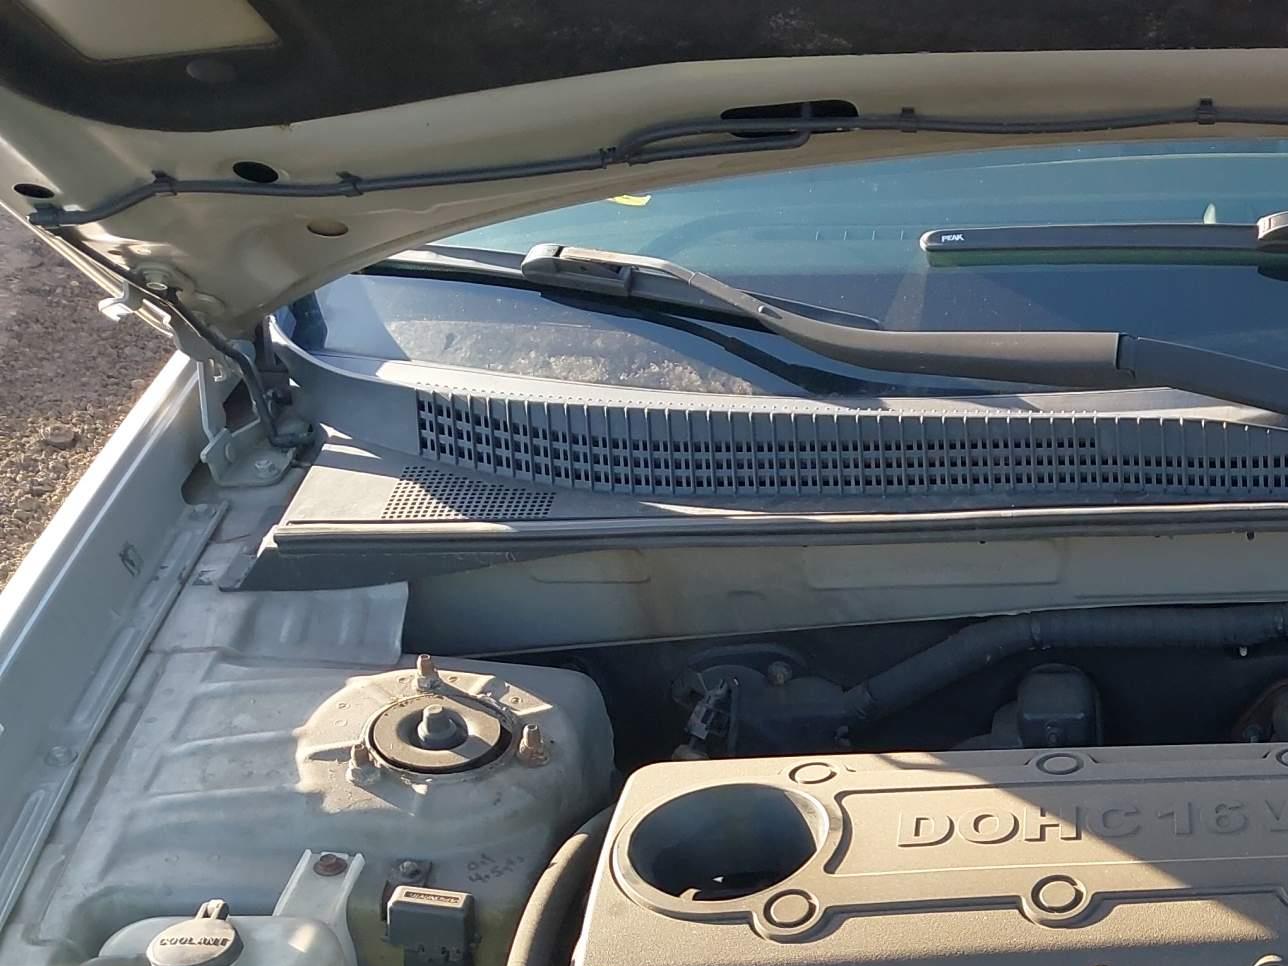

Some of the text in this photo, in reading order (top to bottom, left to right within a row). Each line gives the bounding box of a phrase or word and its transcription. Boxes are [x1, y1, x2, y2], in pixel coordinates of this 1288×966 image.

[941, 233, 965, 243] PEAK
[896, 798, 1144, 848] DOHC
[158, 936, 231, 947] COOLANT
